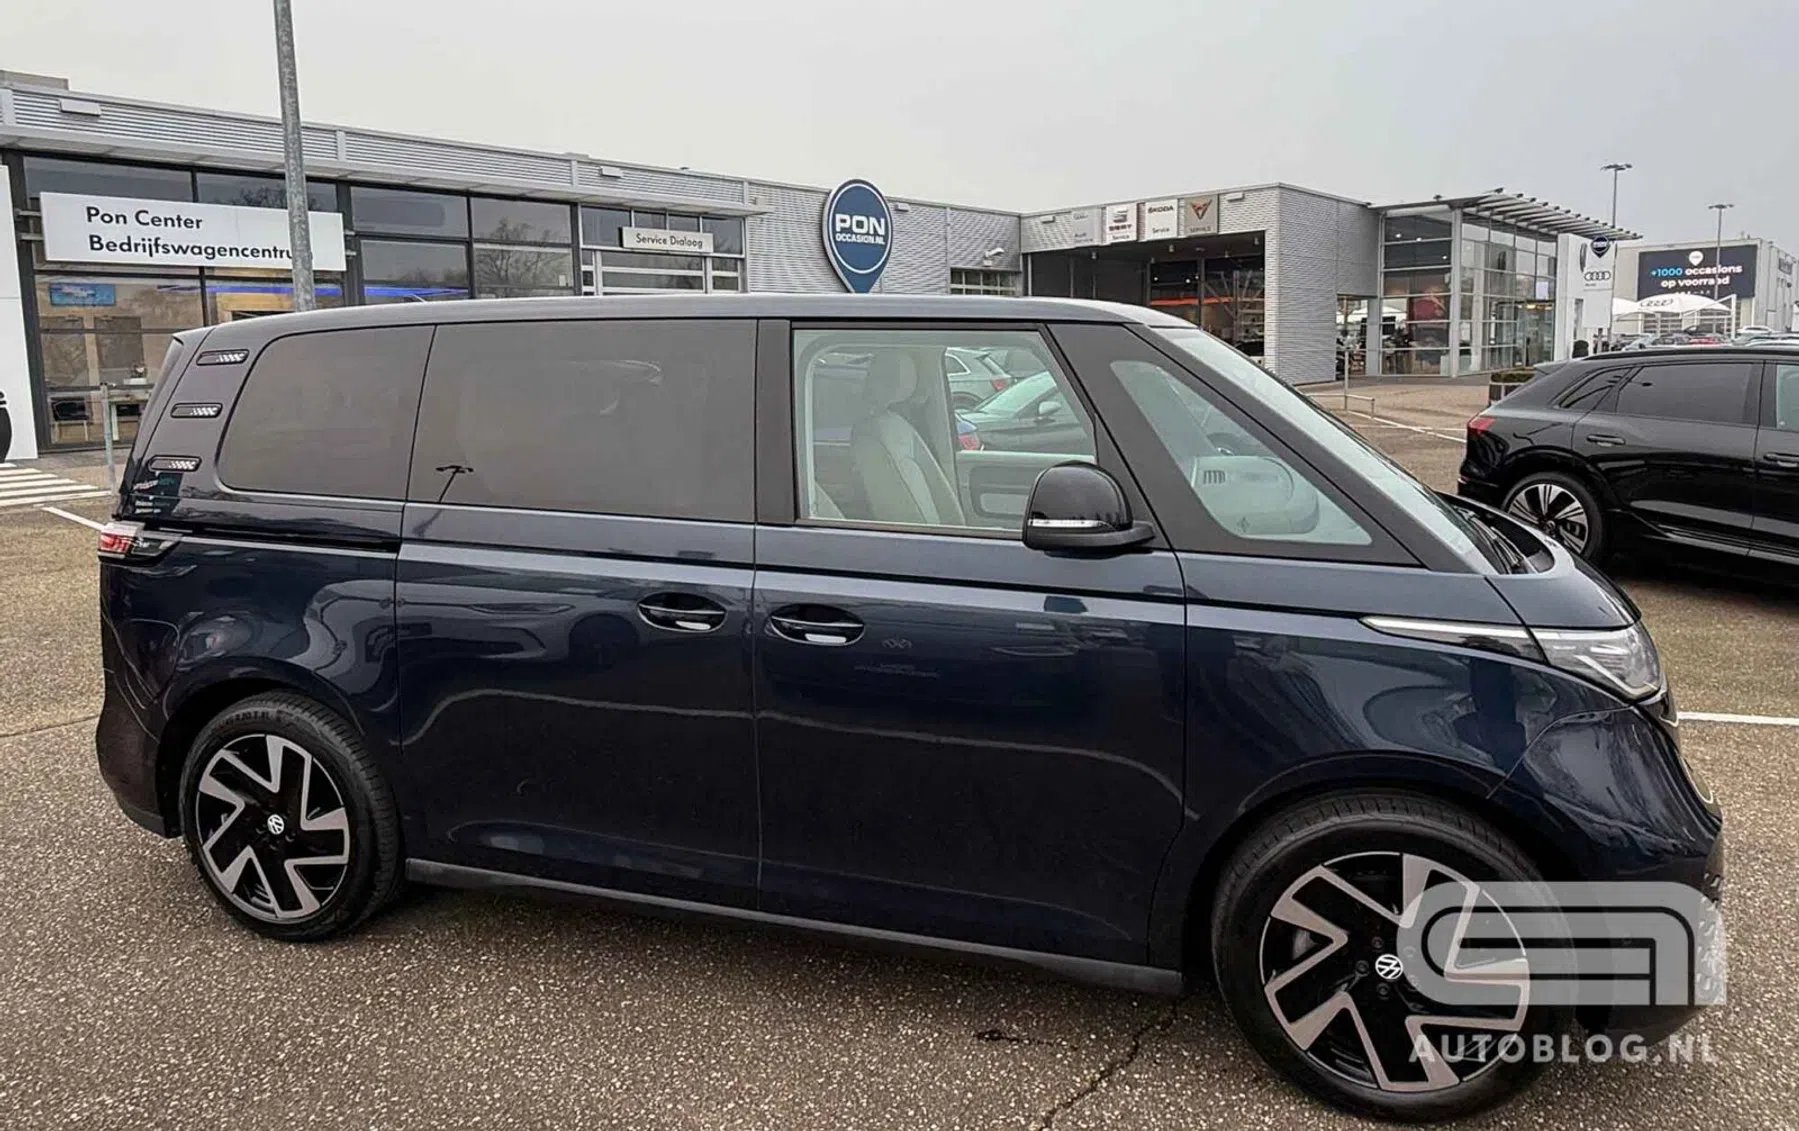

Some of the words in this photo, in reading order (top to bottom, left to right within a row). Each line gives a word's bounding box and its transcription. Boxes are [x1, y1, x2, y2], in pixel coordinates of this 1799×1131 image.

[86, 206, 128, 225] Pon
[135, 209, 203, 229] Center
[835, 213, 885, 236] PON
[89, 234, 313, 260] Bedrijfswagencentru
[636, 233, 668, 245] Service
[670, 235, 703, 249] Dialoog
[1685, 264, 1743, 276] occasions
[1661, 279, 1676, 288] op
